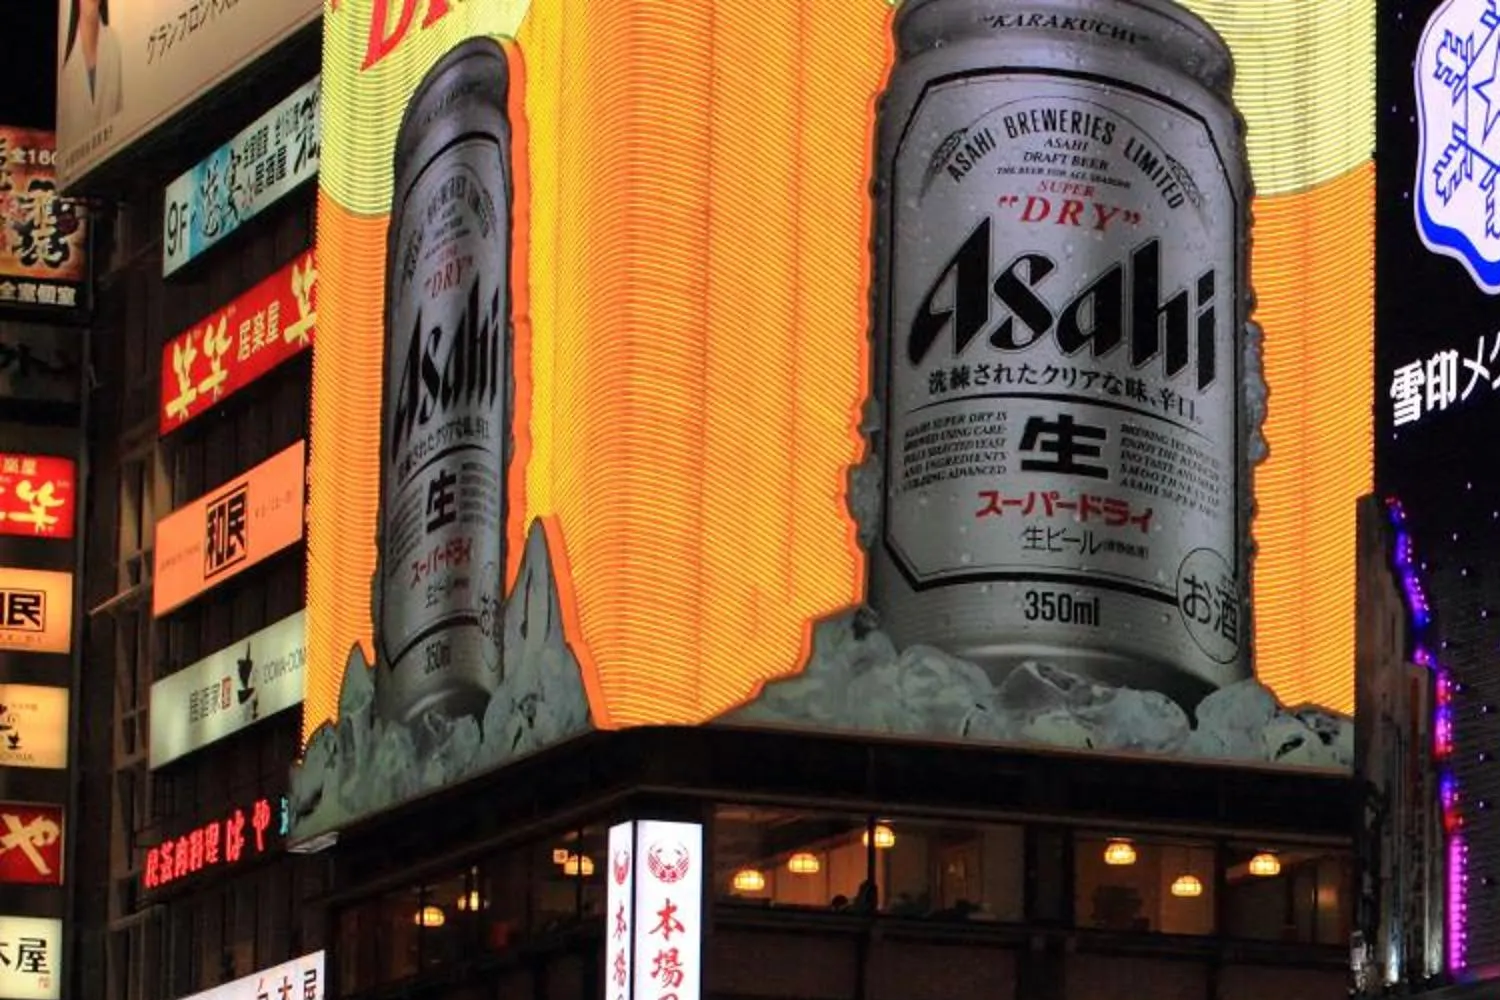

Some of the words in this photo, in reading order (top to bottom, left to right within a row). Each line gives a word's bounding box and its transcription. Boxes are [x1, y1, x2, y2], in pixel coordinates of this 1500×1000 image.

[946, 127, 997, 184] ASAHI
[1003, 107, 1116, 145] BREWERIES
[1123, 137, 1185, 211] LIMITED
[1023, 151, 1069, 166] DRAFT
[1071, 155, 1109, 171] BEER
[1043, 136, 1089, 152] ASAHI
[1036, 180, 1095, 198] SUPER
[167, 201, 189, 257] 9F
[907, 215, 1217, 393] Asahi
[391, 272, 500, 466] Asahi
[1019, 413, 1109, 480] 生
[426, 468, 457, 534] 生
[974, 489, 1154, 534] スーパードライ
[1022, 526, 1102, 555] 生ビール
[1024, 590, 1101, 628] 350ml
[1182, 572, 1241, 651] お酒
